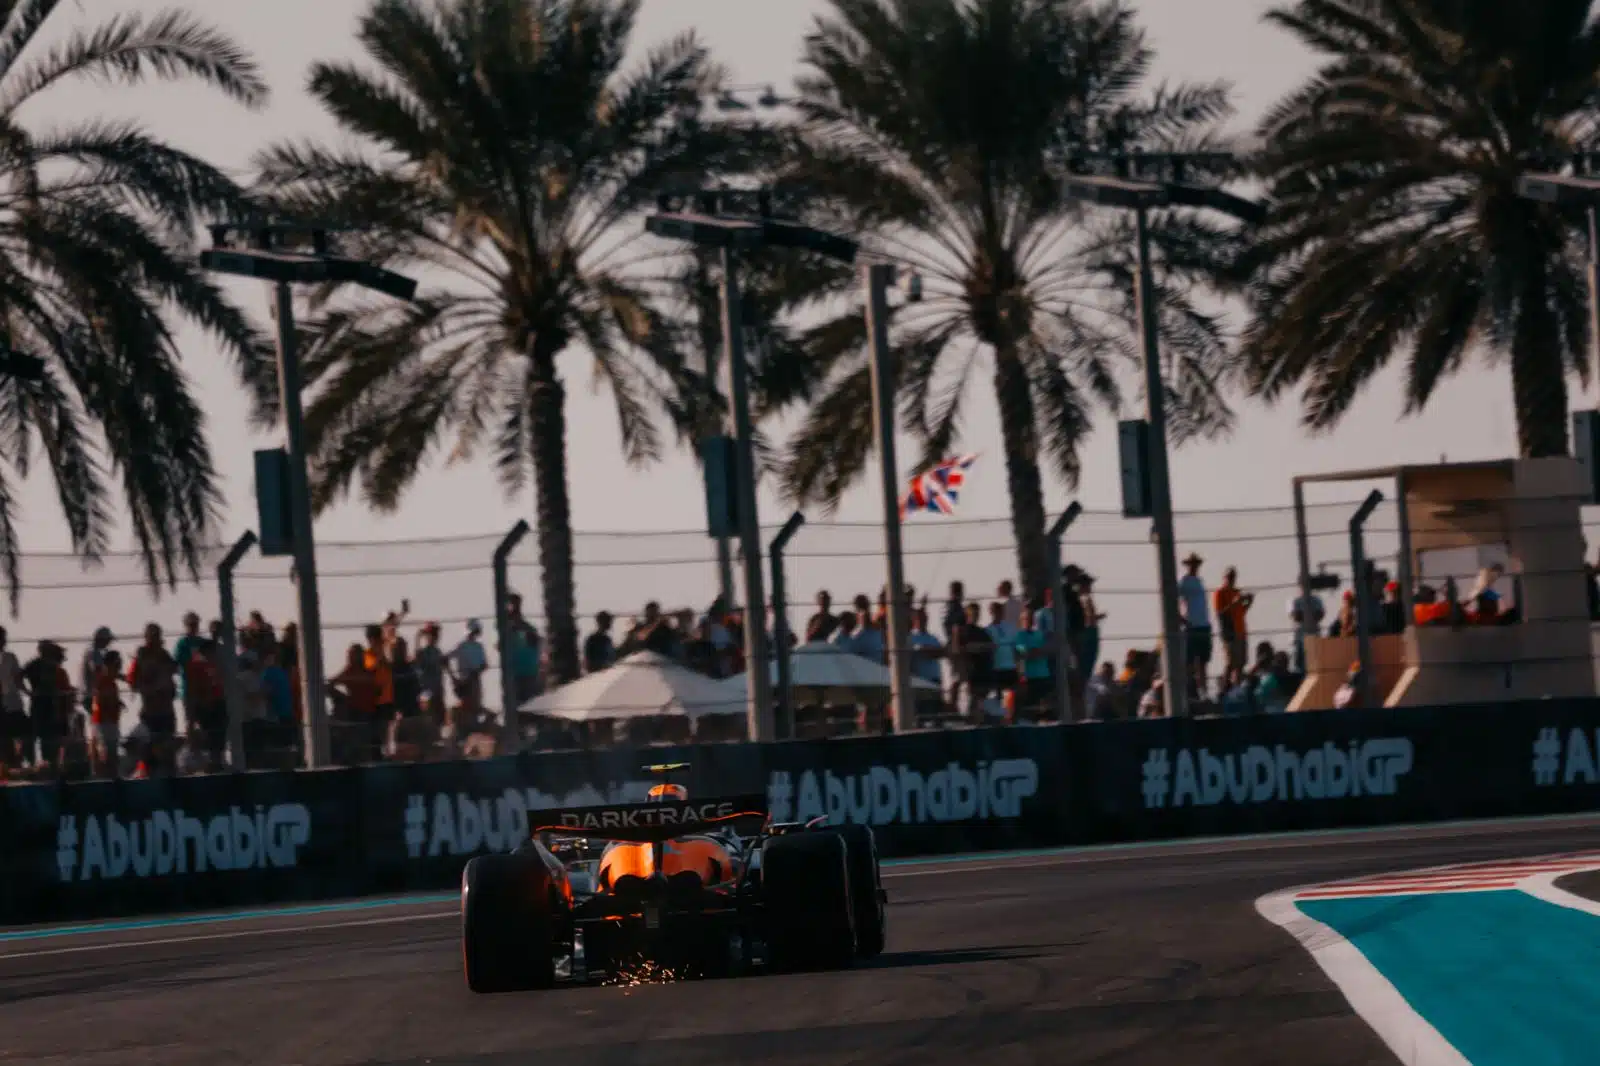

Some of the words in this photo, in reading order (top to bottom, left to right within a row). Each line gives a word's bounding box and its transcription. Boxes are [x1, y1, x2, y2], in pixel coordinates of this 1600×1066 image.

[767, 757, 1039, 826] #AbuDhabiGP
[1141, 736, 1414, 808] #AbuDhabiGP
[56, 802, 312, 882] #AbuDhabiGP
[560, 802, 733, 829] DARKTRACE
